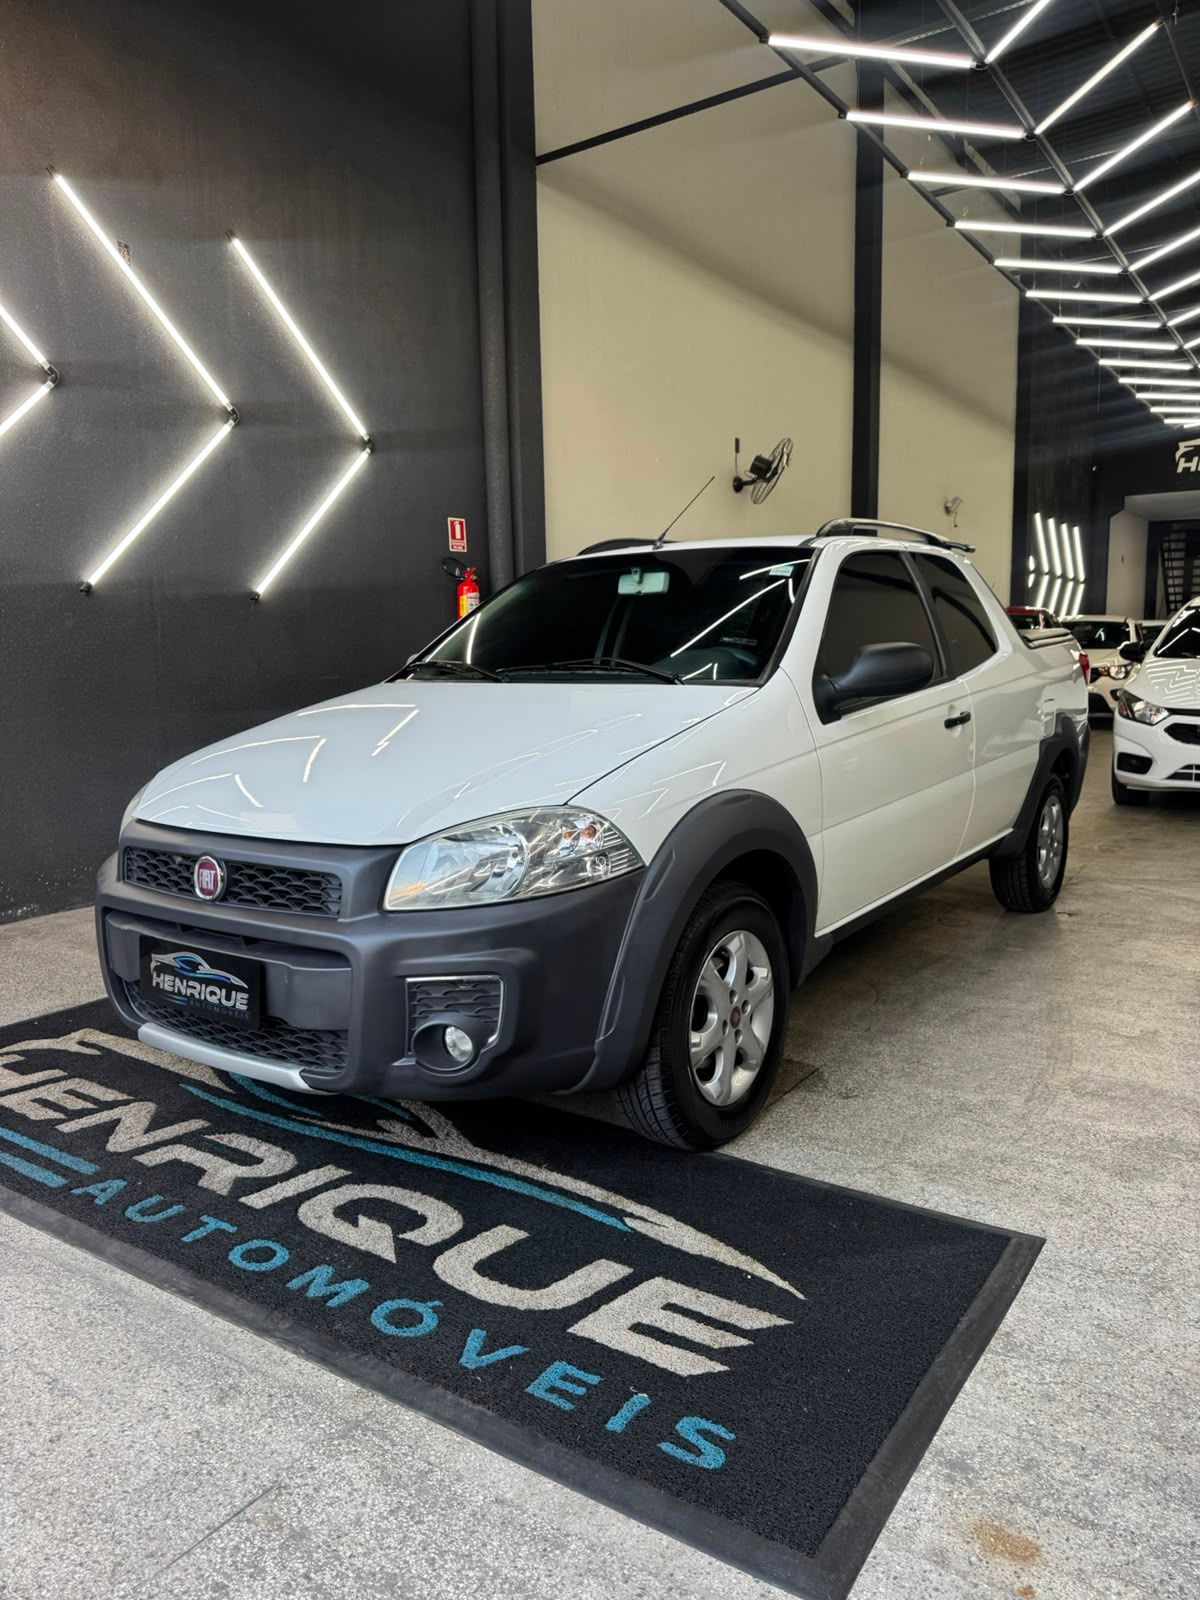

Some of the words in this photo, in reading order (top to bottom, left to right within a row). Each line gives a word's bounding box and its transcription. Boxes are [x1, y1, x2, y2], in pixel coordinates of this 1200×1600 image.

[199, 868, 217, 890] FIAT
[151, 972, 249, 1011] HENRIQUE
[71, 1178, 736, 1470] AUTOMÓVEIS
